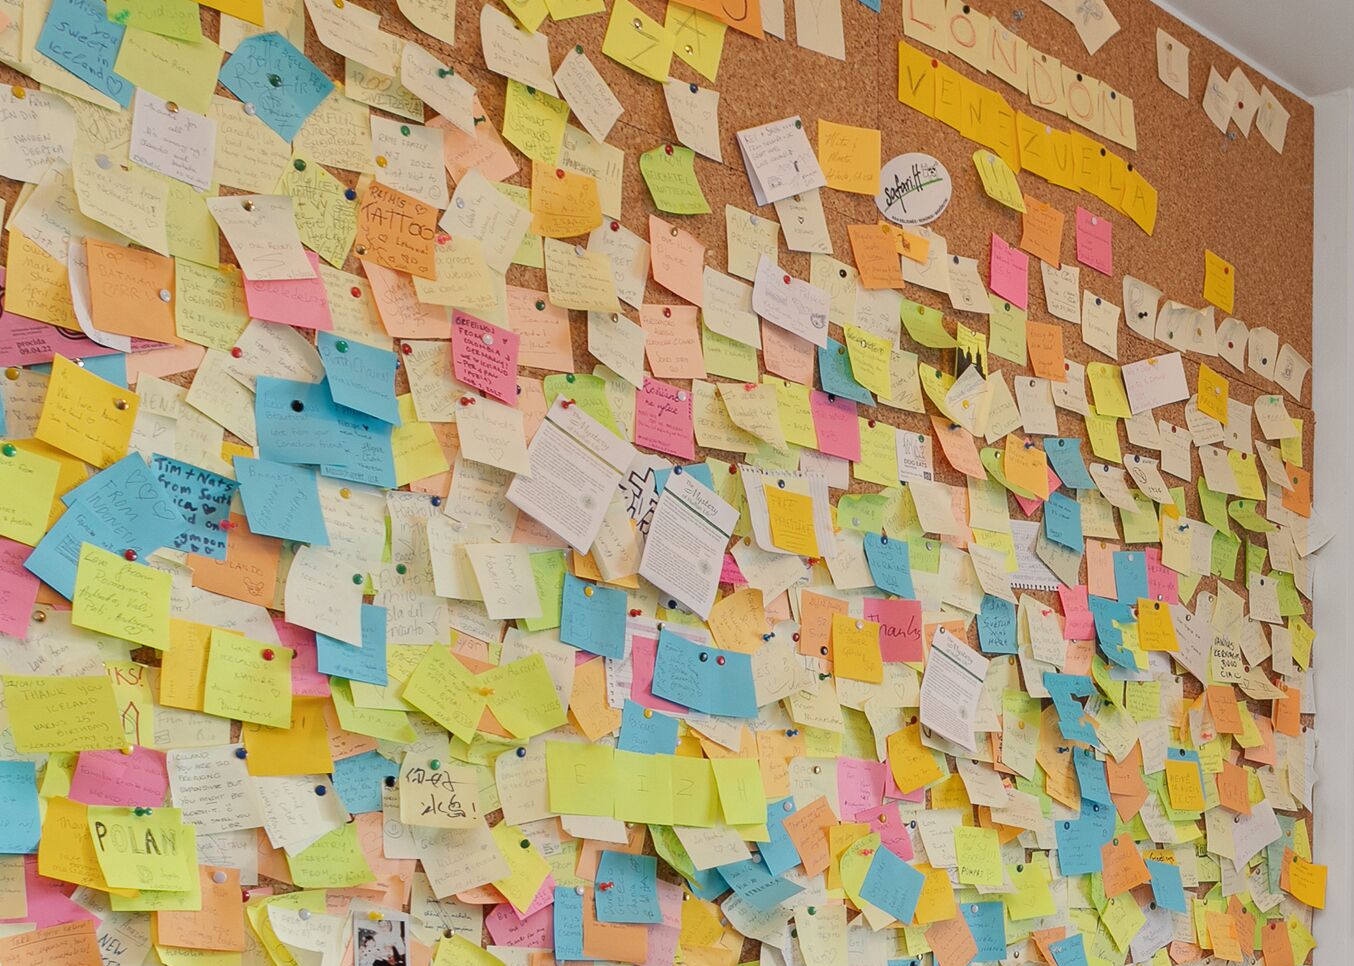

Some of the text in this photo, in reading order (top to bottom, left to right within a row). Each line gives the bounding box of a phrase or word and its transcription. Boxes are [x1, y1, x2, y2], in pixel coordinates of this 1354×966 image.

[910, 0, 1126, 138] LONDON
[154, 456, 182, 477] Tim
[197, 473, 234, 492] Nats
[100, 479, 139, 522] FROM
[20, 683, 104, 702] THANK YOU
[46, 697, 97, 714] ICELAND
[56, 721, 110, 738] BIRTHDAY
[97, 932, 129, 957] NEW
